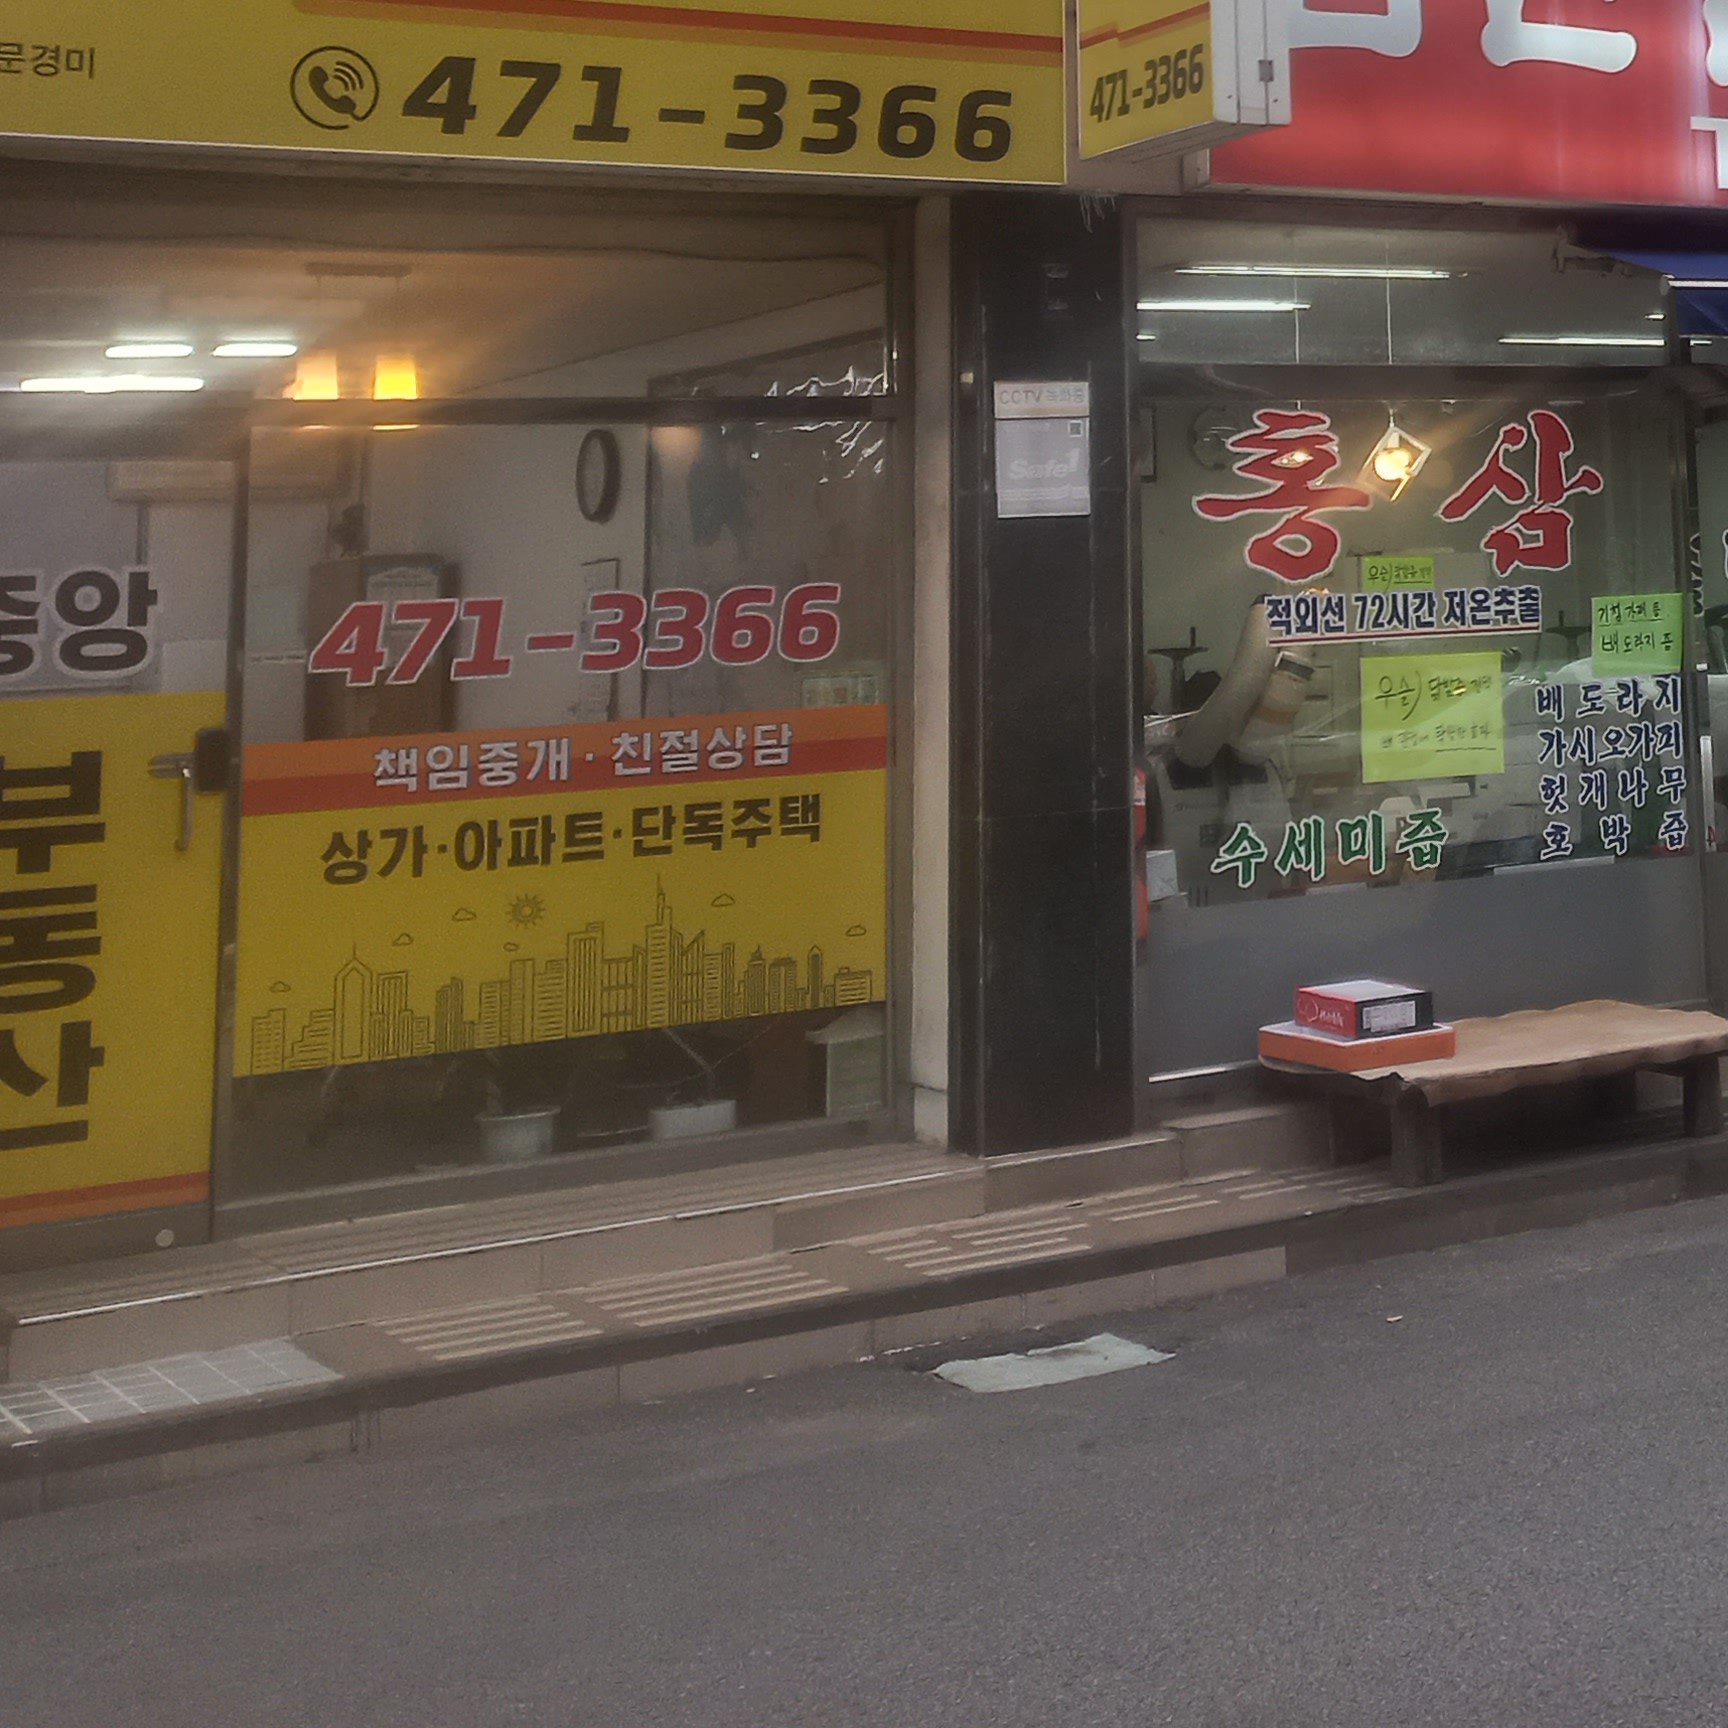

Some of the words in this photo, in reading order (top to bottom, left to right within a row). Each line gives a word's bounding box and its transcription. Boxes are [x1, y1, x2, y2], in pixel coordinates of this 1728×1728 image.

[400, 53, 1012, 164] 471-3366
[1089, 43, 1204, 124] 471-3366
[999, 389, 1042, 405] CCTV
[1192, 409, 1603, 582] 홍삼
[307, 582, 842, 688] 471-3366
[1265, 594, 1347, 635] 적외선
[1353, 591, 1436, 631] 72시간
[1443, 586, 1541, 626] 저온추출
[373, 736, 570, 793] 책임중개
[611, 723, 794, 779] 친절상담
[1538, 723, 1684, 766] 가시오가피
[1211, 809, 1450, 888] 수세미즙
[0, 748, 105, 1152] 부동산
